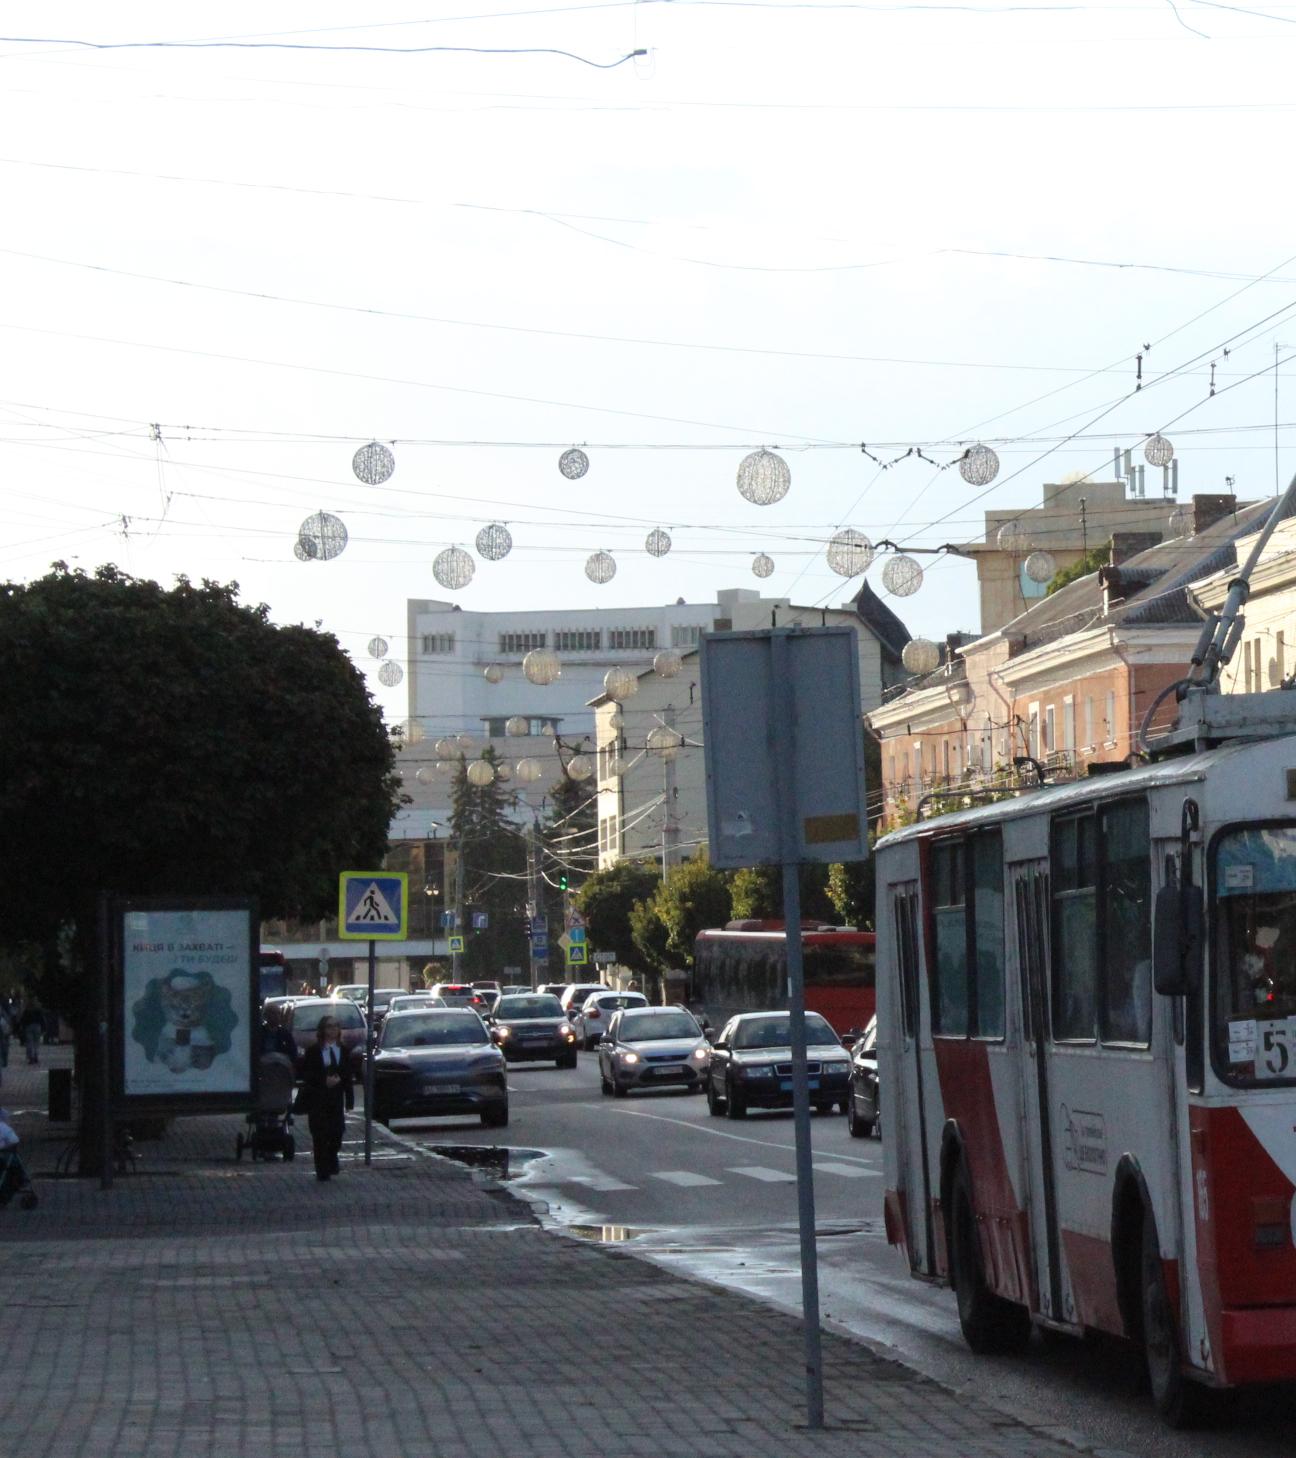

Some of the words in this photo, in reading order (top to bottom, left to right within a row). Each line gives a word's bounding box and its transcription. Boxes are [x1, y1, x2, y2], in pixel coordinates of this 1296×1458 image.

[167, 943, 174, 952] В
[178, 942, 223, 952] ЗАХВАТІ
[181, 955, 195, 963] ТИ
[1263, 1030, 1289, 1074] 5
